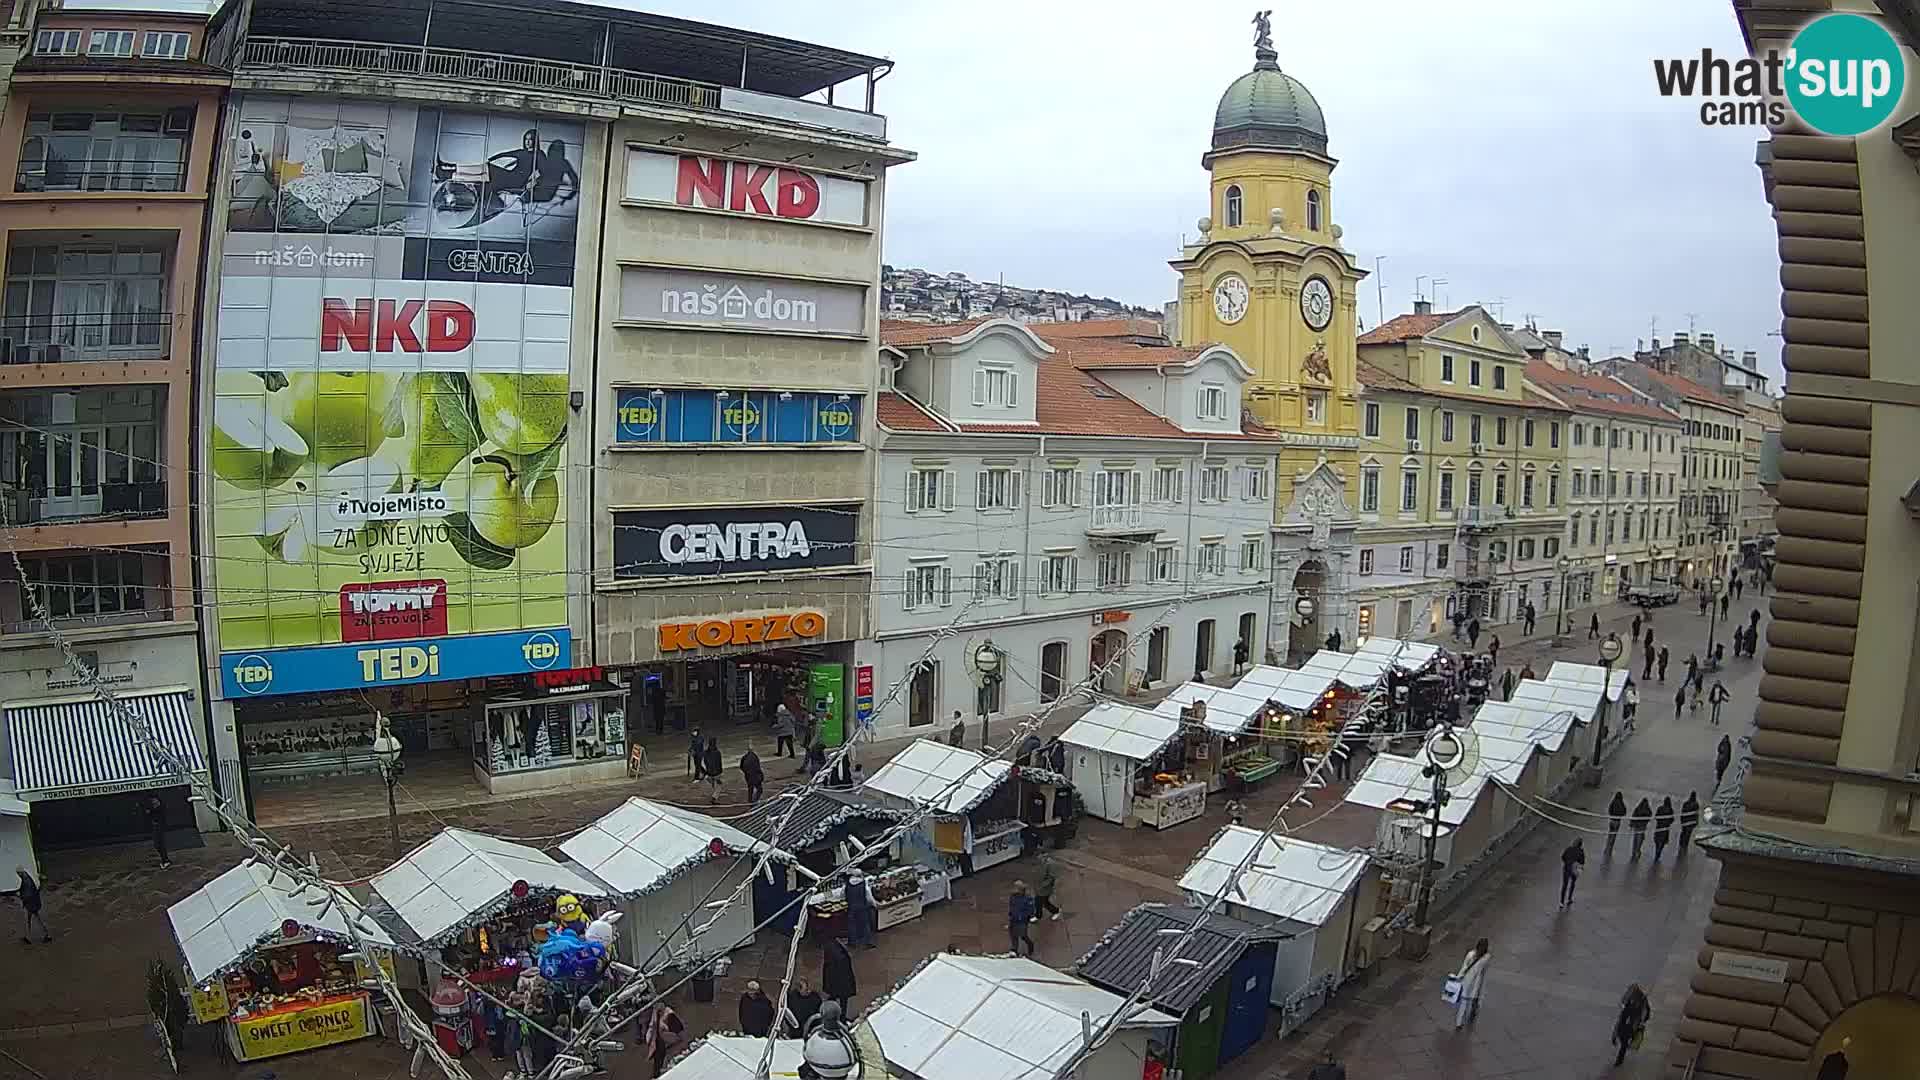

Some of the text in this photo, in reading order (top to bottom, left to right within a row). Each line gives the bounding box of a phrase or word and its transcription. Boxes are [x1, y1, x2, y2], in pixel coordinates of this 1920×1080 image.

[675, 154, 821, 219] NKD
[255, 245, 366, 268] naš dom
[447, 249, 534, 275] CENTRA
[661, 283, 816, 322] naš dom
[320, 298, 476, 352] NKD
[618, 408, 657, 424] TEDi
[723, 409, 760, 425] TEDi
[819, 411, 853, 426] TEDi
[338, 497, 446, 516] #TvojeMisto
[333, 523, 451, 549] ZA DNEVNO
[659, 520, 810, 564] CENTRA
[359, 547, 425, 575] SVJEŽE
[348, 585, 438, 614] TOMMY
[659, 612, 826, 653] KORZO
[358, 645, 439, 683] TEDi
[522, 643, 560, 661] TEDi
[233, 665, 272, 683] TEDi
[250, 1021, 293, 1041] SWEET
